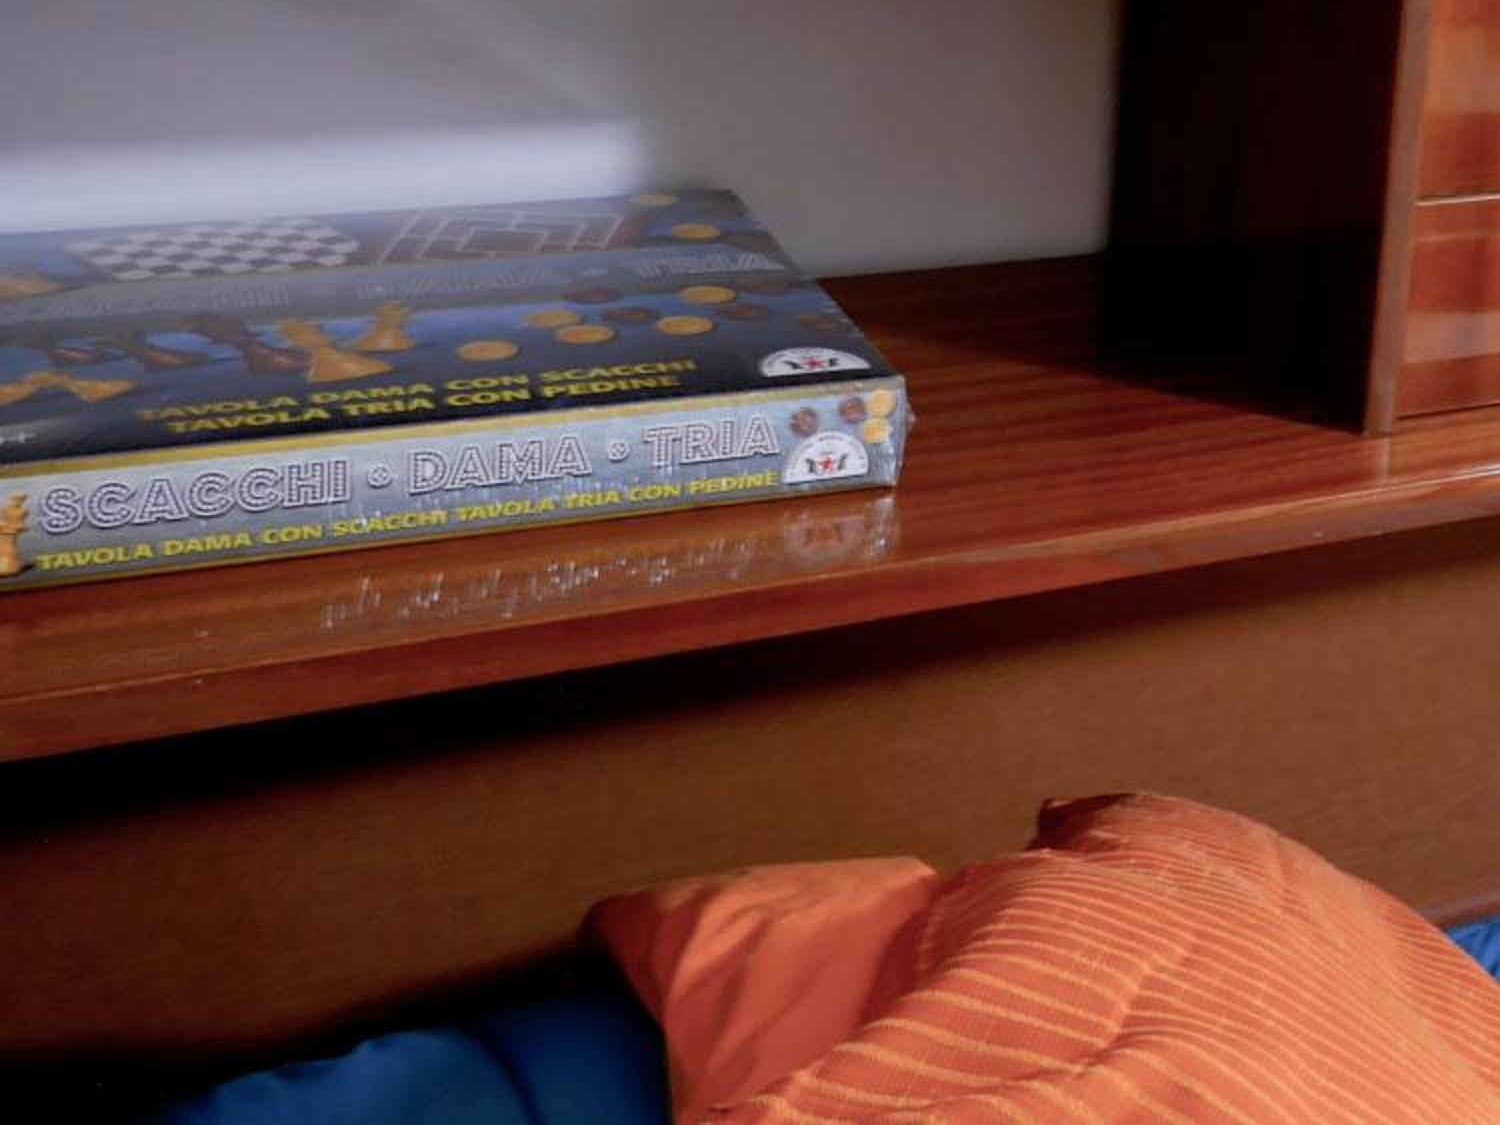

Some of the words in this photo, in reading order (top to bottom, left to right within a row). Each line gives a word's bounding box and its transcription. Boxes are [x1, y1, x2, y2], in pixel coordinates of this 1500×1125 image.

[166, 407, 331, 433] TAVOLA
[343, 397, 434, 416] TRIA
[448, 388, 531, 406] CON
[541, 376, 684, 399] PEDINE
[309, 382, 434, 405] DAMA
[446, 374, 530, 392] CON
[540, 359, 697, 383] SCACCHI
[40, 458, 353, 534] SCACCHI
[408, 433, 592, 496] DAMA
[643, 412, 782, 468] TRIA
[36, 544, 154, 571] TAVOLA
[161, 533, 253, 557] DAMA
[260, 524, 323, 545] CON
[332, 512, 448, 536] SCACCHI
[457, 499, 555, 522] TAVOLA
[564, 490, 620, 509] TRIA
[628, 483, 681, 502] CON
[686, 472, 779, 495] PEDINE
